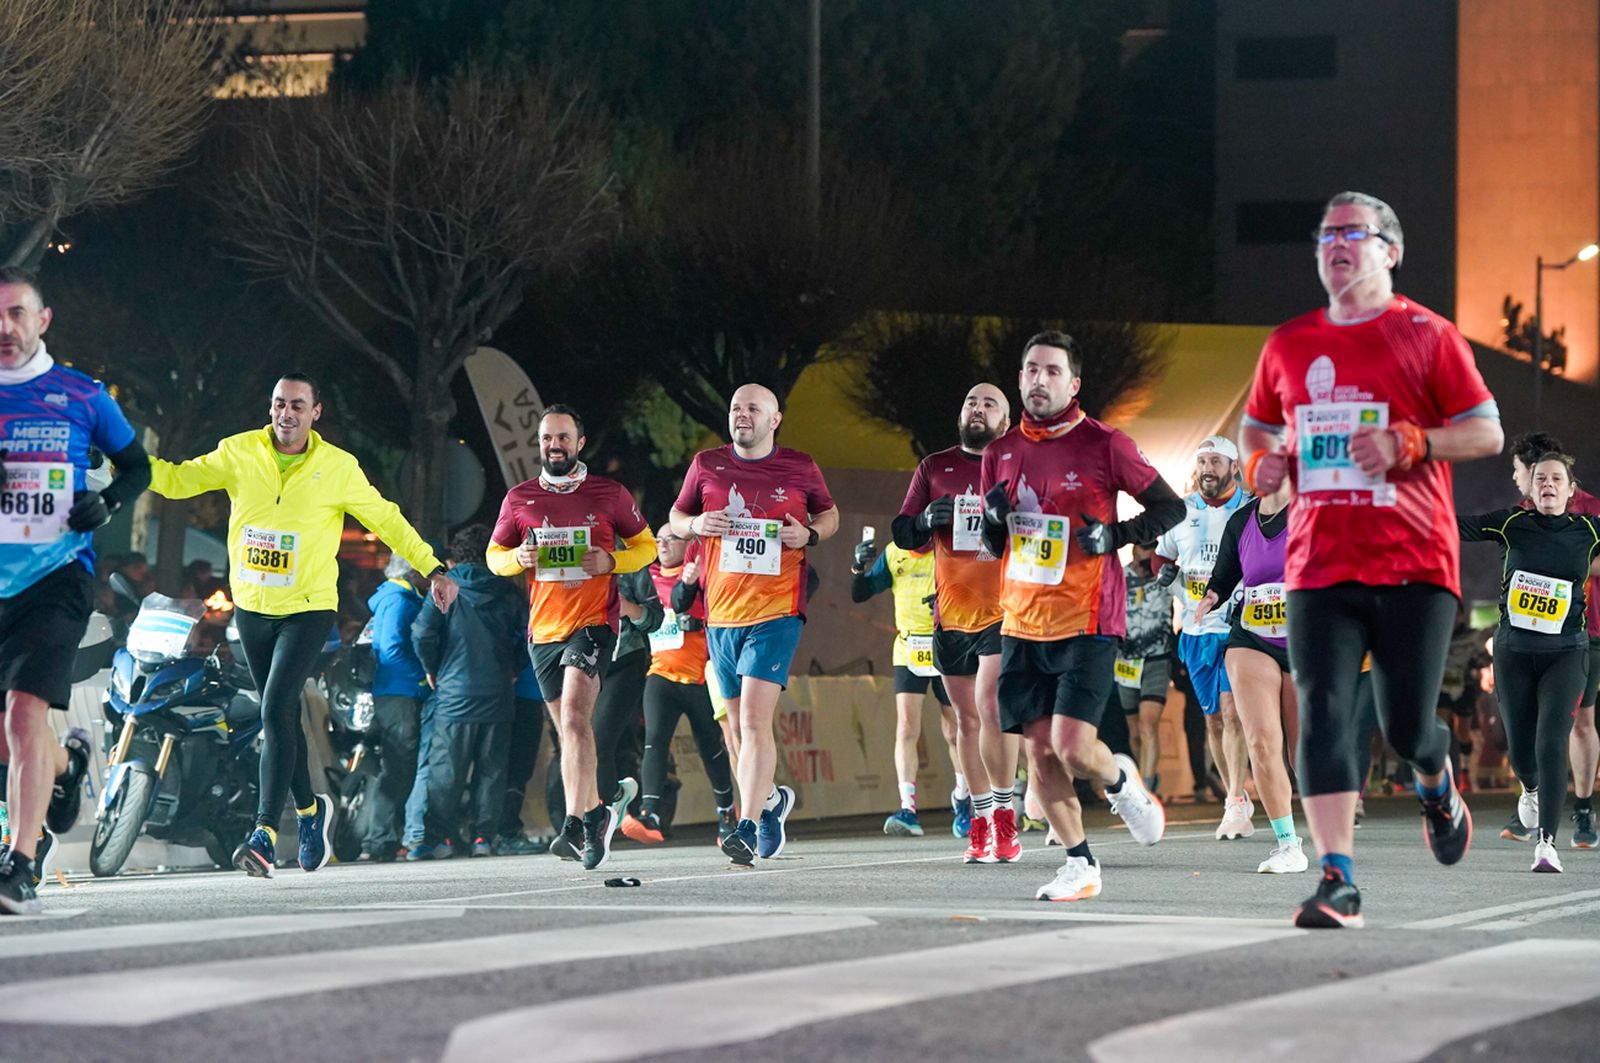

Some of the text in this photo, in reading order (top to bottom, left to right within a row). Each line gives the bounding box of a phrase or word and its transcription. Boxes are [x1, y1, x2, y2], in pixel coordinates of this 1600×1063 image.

[13, 427, 70, 439] MEDIO
[1, 491, 54, 516] 6818
[753, 523, 760, 531] DE
[549, 546, 575, 562] 491
[735, 537, 766, 556] 490
[247, 547, 289, 569] 13381
[1516, 583, 1529, 592] SAN
[1525, 579, 1551, 589] NOCHE DE
[1518, 592, 1558, 615] 6758
[917, 650, 932, 662] 84
[779, 711, 812, 745] SAN
